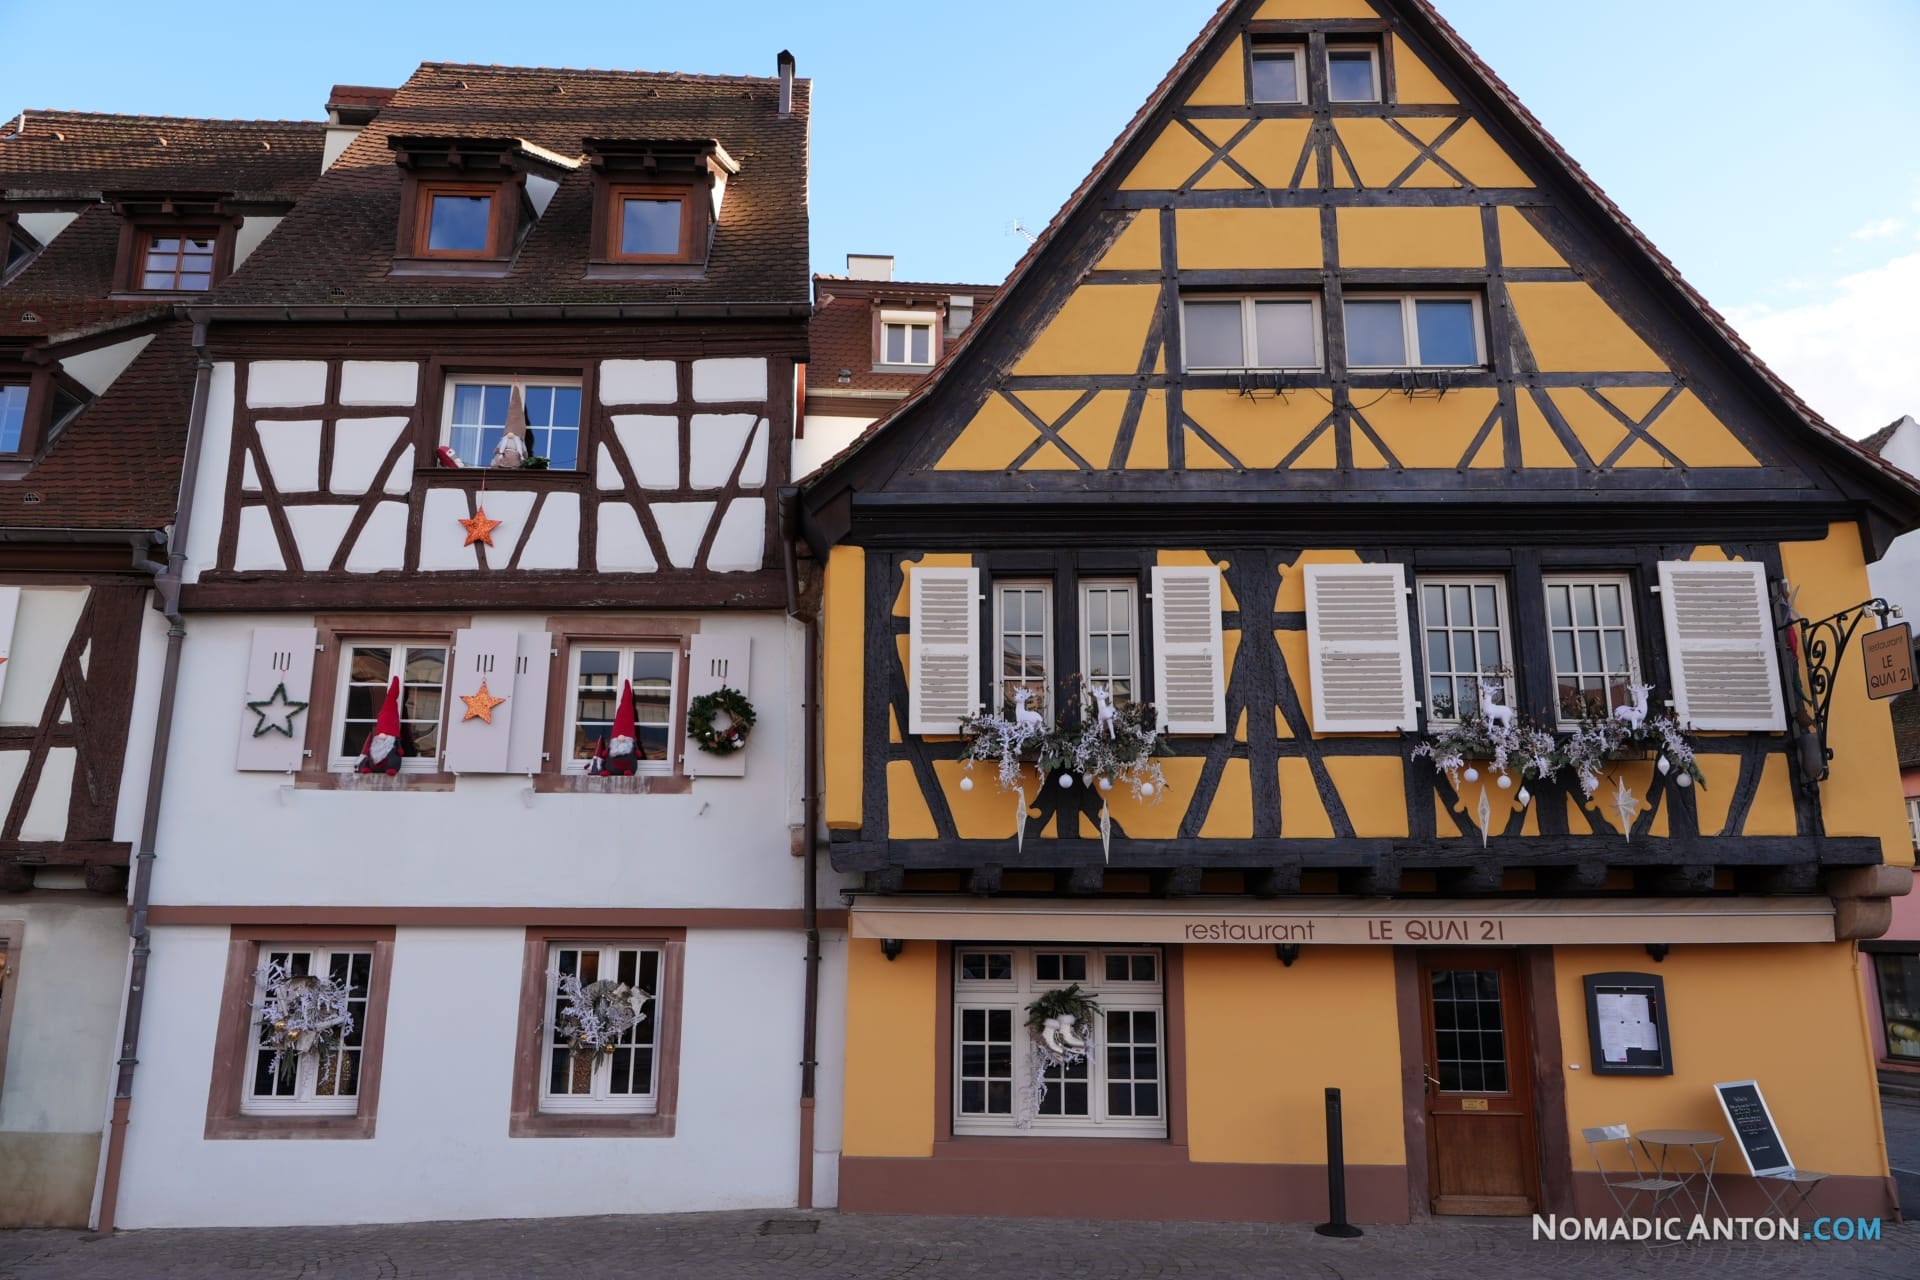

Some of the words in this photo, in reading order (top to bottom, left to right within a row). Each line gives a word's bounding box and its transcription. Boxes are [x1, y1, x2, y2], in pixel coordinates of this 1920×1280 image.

[1882, 654, 1893, 669] LE
[1871, 671, 1896, 688] QUAI
[1900, 667, 1910, 681] 21
[1185, 920, 1315, 940] restaurant
[1368, 920, 1393, 940] LE
[1405, 920, 1469, 941] QUAI
[1480, 920, 1504, 941] 21
